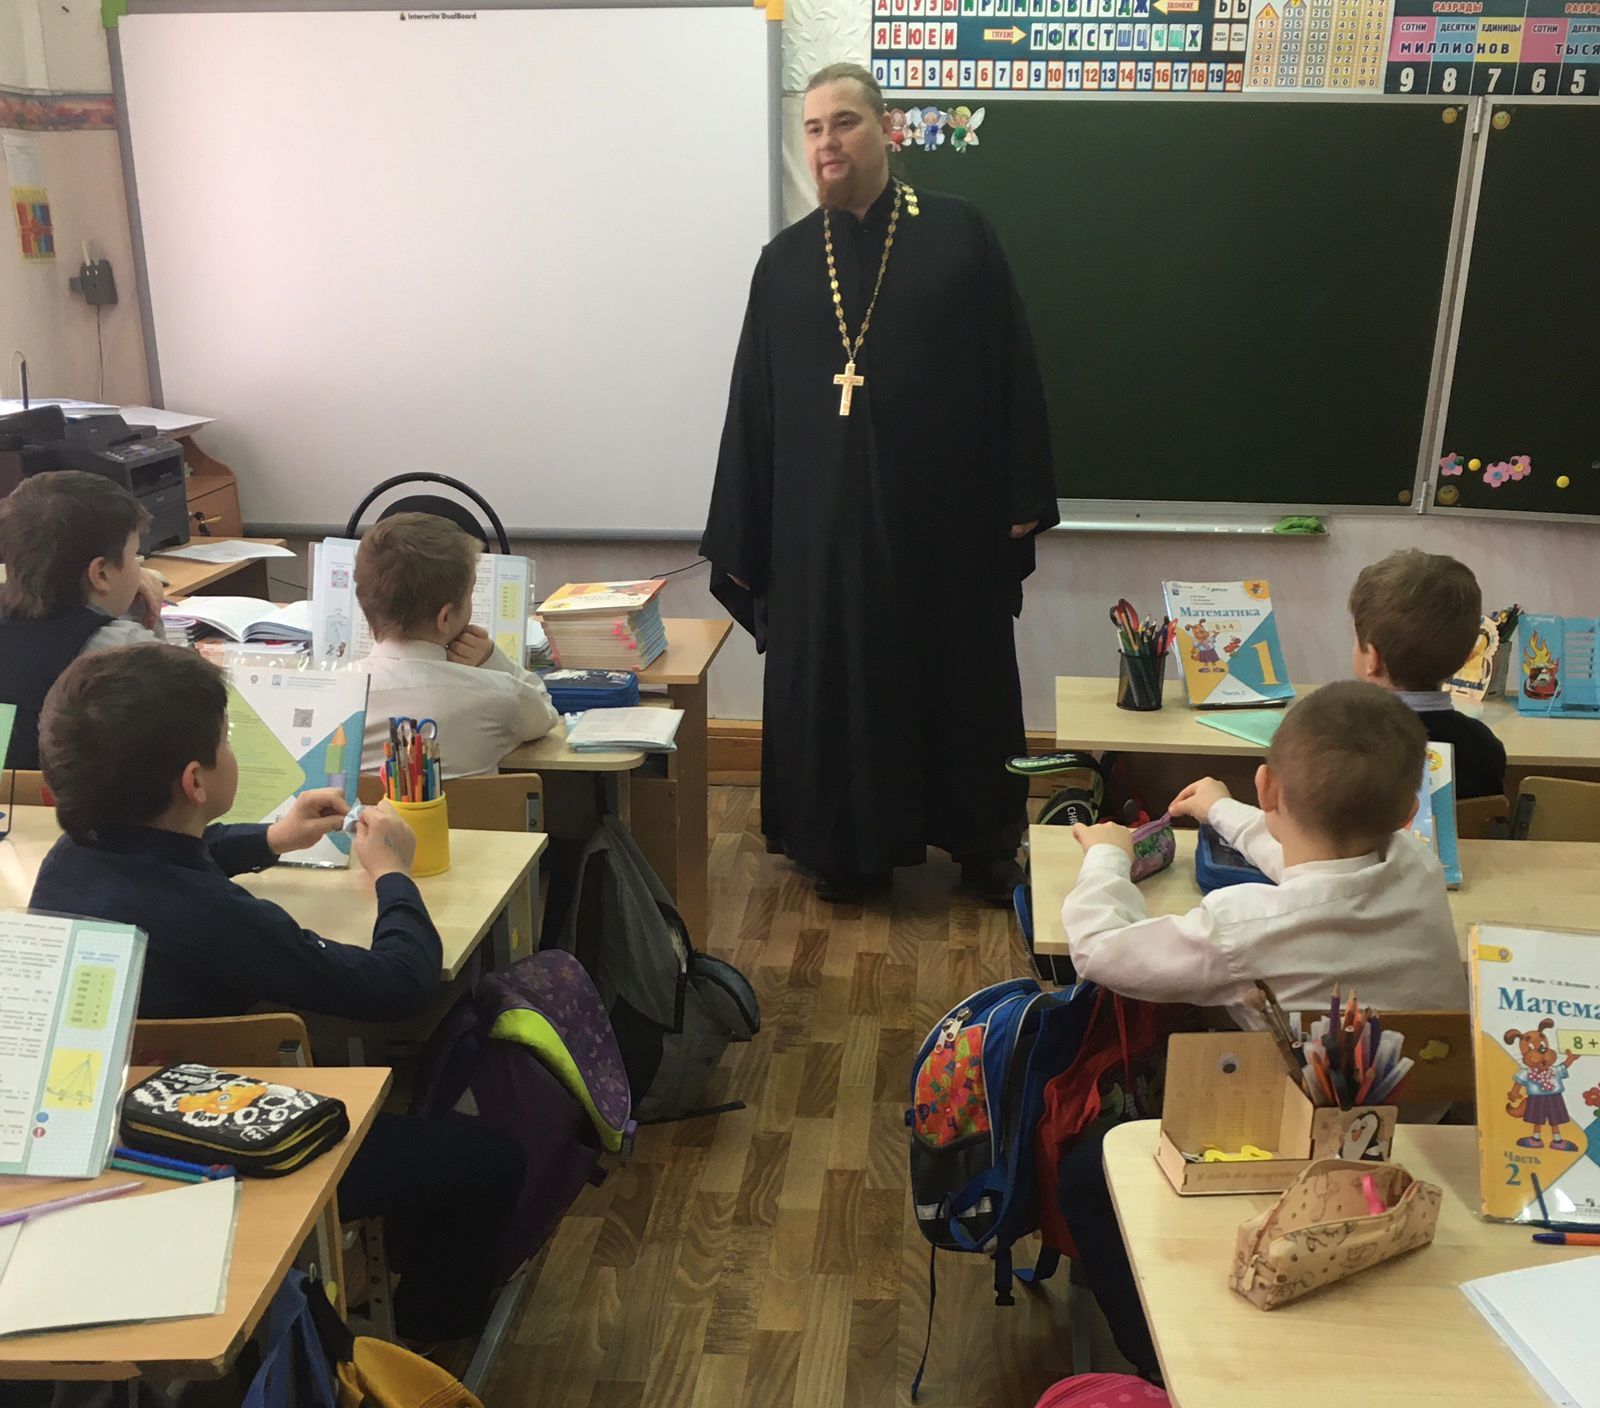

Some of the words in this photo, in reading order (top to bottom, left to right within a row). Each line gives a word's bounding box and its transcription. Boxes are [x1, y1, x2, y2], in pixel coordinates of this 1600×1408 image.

[1433, 2, 1484, 12] РАЗРЯДЫ
[876, 28, 887, 45] Я
[893, 24, 902, 45] Ё
[908, 28, 922, 45] Ю
[928, 28, 936, 45] Е
[944, 28, 954, 45] И
[1440, 24, 1476, 32] ДЕСЯТКИ
[1482, 24, 1522, 33] ЕДИНИЦЫ
[1033, 30, 1044, 46] П
[1048, 29, 1062, 46] Ф
[1068, 30, 1079, 46] К
[1087, 30, 1096, 46] С
[1104, 30, 1114, 46] Т
[1118, 30, 1132, 47] Ш
[1136, 30, 1148, 49] Ц
[1154, 30, 1164, 48] Ч
[1168, 30, 1184, 49] Щ
[1188, 30, 1200, 48] Х
[1400, 42, 1510, 54] МИЛЛИОНОВ
[876, 66, 884, 80] 0
[894, 67, 900, 80] 1
[911, 67, 918, 80] 2
[928, 67, 936, 80] 3
[946, 68, 954, 81] 4
[964, 68, 972, 81] 5
[981, 68, 988, 82] 6
[1000, 68, 1006, 82] 7
[1016, 68, 1024, 82] 8
[1034, 68, 1042, 82] 9
[1048, 68, 1062, 82] 10
[1068, 68, 1080, 82] 11
[1085, 68, 1098, 82] 12
[1102, 68, 1116, 82] 13
[1120, 68, 1134, 82] 14
[1138, 68, 1152, 82] 15
[1156, 69, 1169, 83] 16
[1174, 69, 1188, 83] 17
[1192, 69, 1205, 83] 18
[1210, 69, 1224, 83] 19
[1226, 70, 1242, 84] 20
[1400, 67, 1415, 92] 9
[1442, 68, 1458, 93] 8
[1488, 68, 1502, 93] 7
[1532, 69, 1546, 94] 6
[1570, 70, 1586, 94] 5
[1180, 606, 1260, 616] Математика
[1250, 640, 1283, 685] 1
[1573, 1036, 1583, 1050] 8
[1504, 1150, 1541, 1164] Часть
[1505, 1164, 1521, 1186] 2
